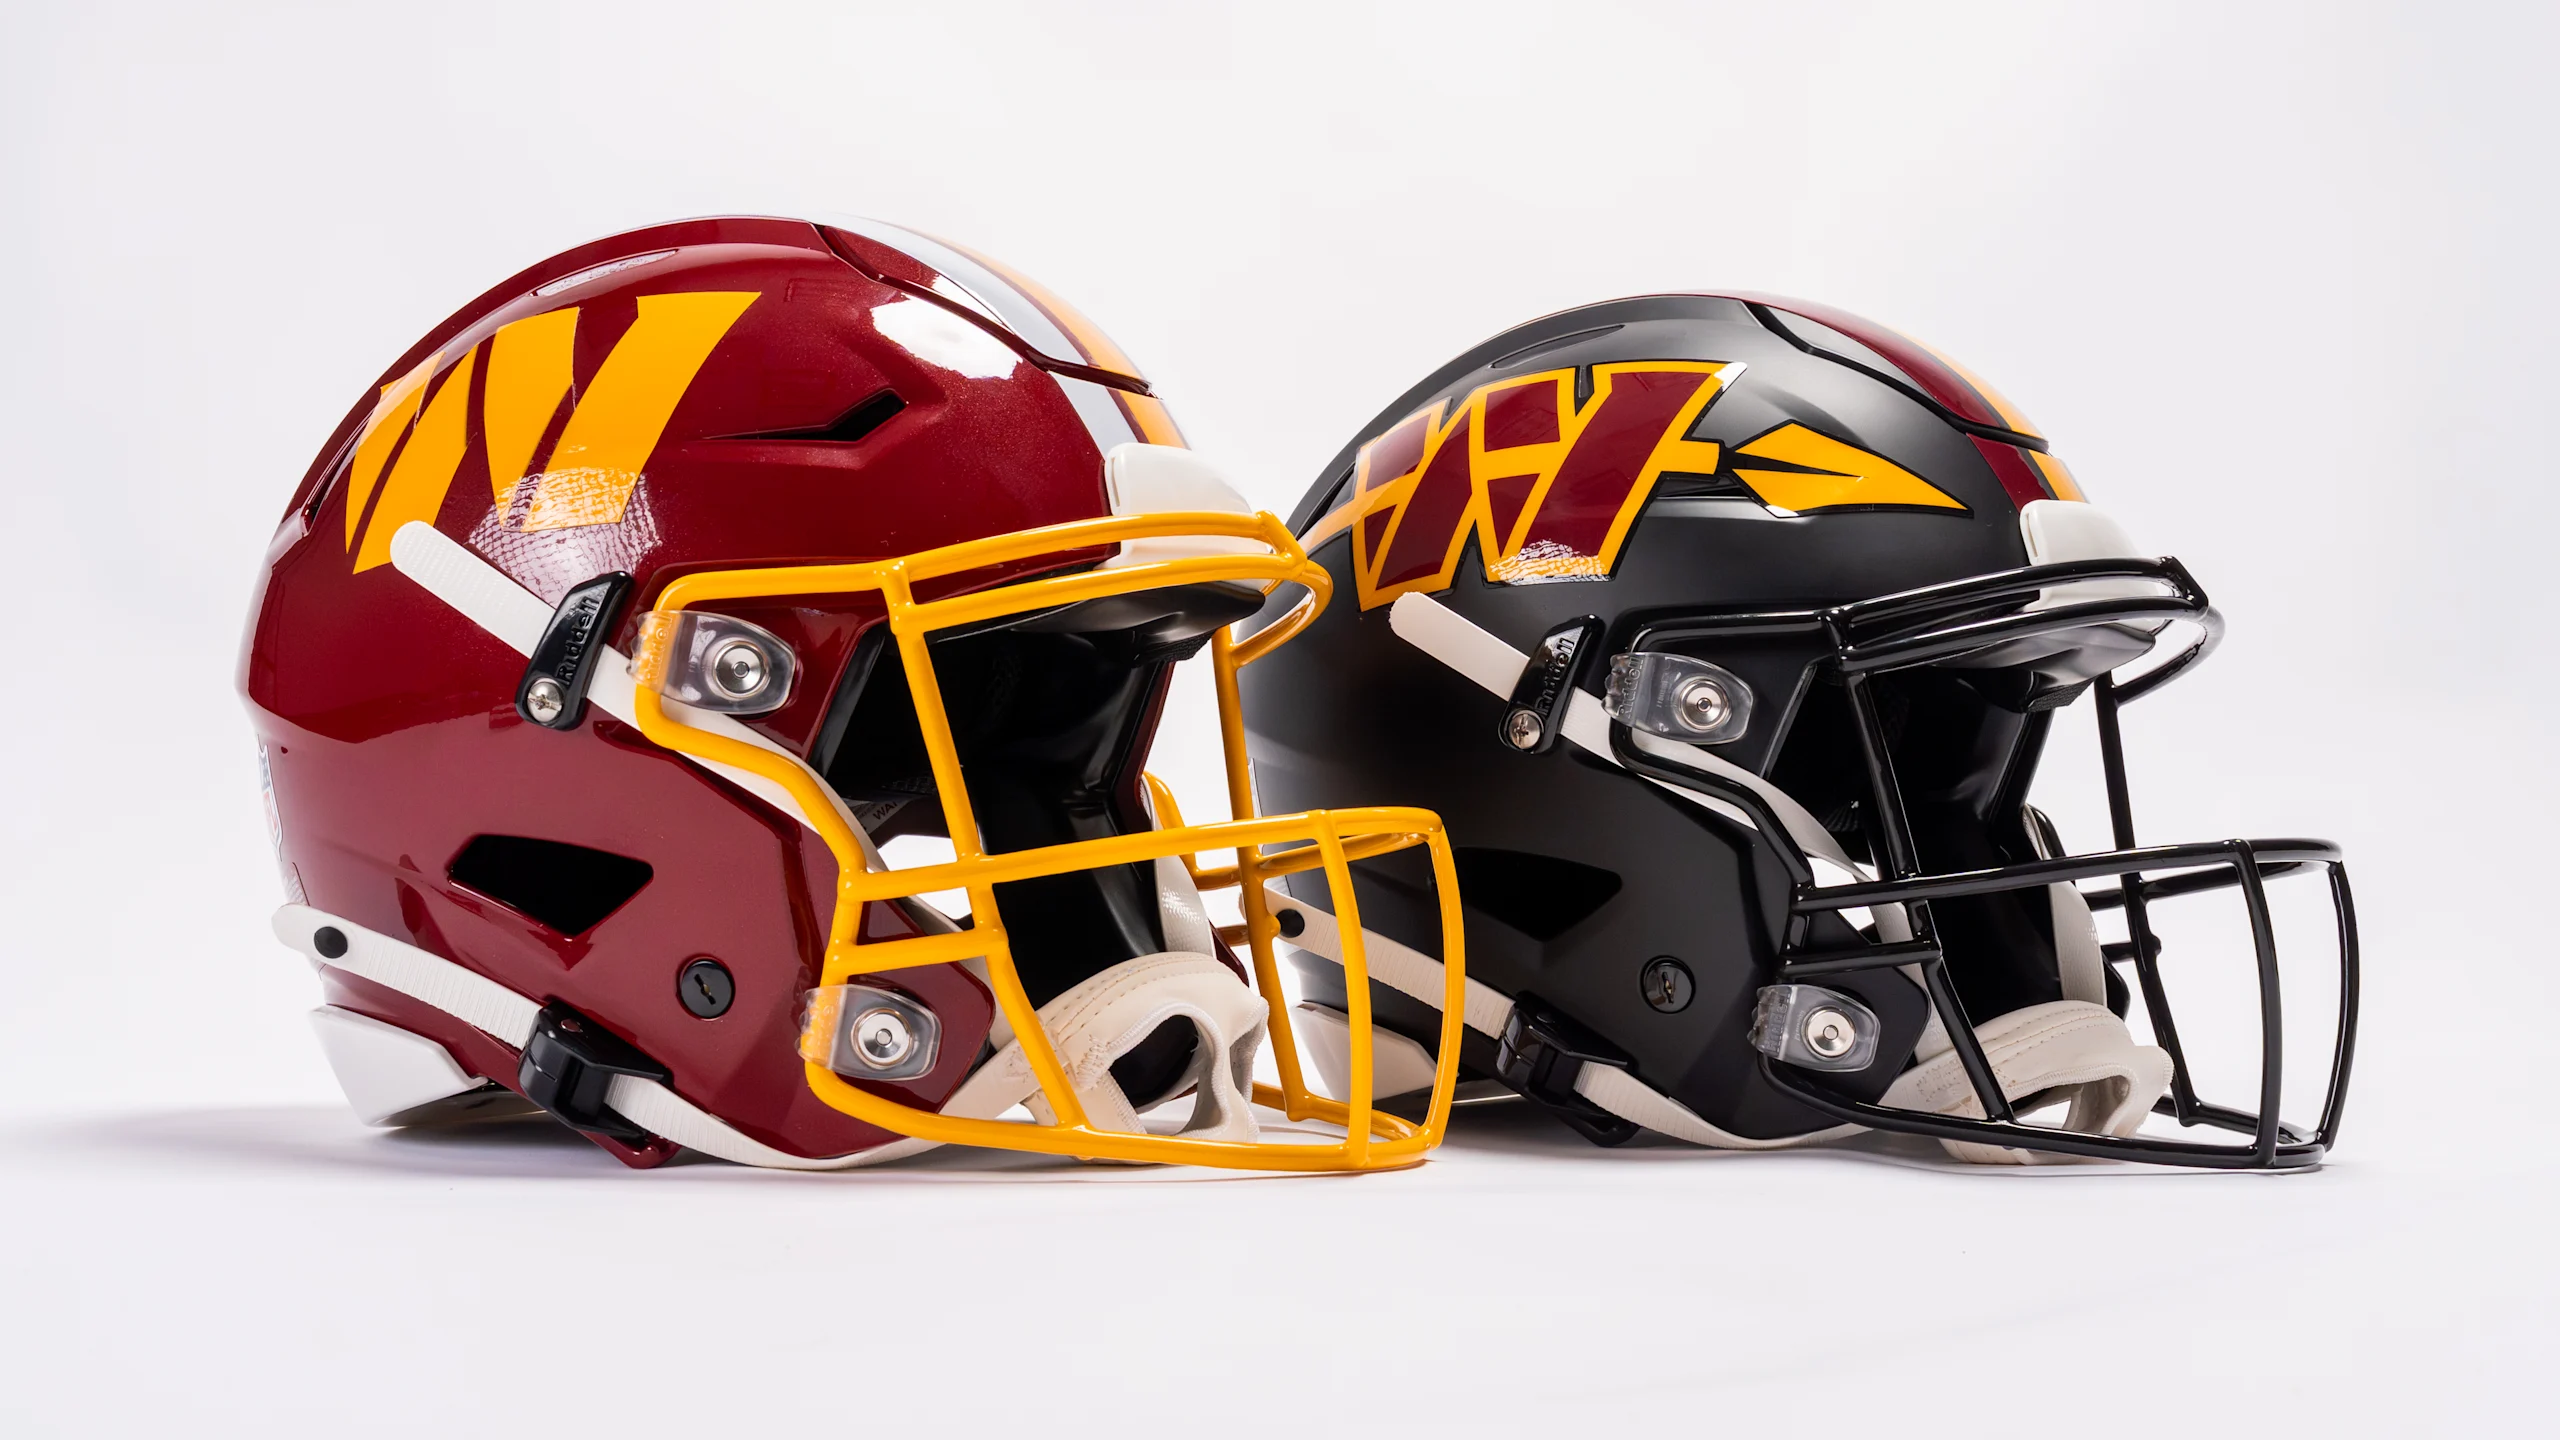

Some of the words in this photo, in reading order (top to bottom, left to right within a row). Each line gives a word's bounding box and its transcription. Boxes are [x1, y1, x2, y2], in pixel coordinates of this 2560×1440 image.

[345, 291, 762, 575] W
[555, 596, 600, 686] Riddell
[1616, 656, 1645, 720] Riddell
